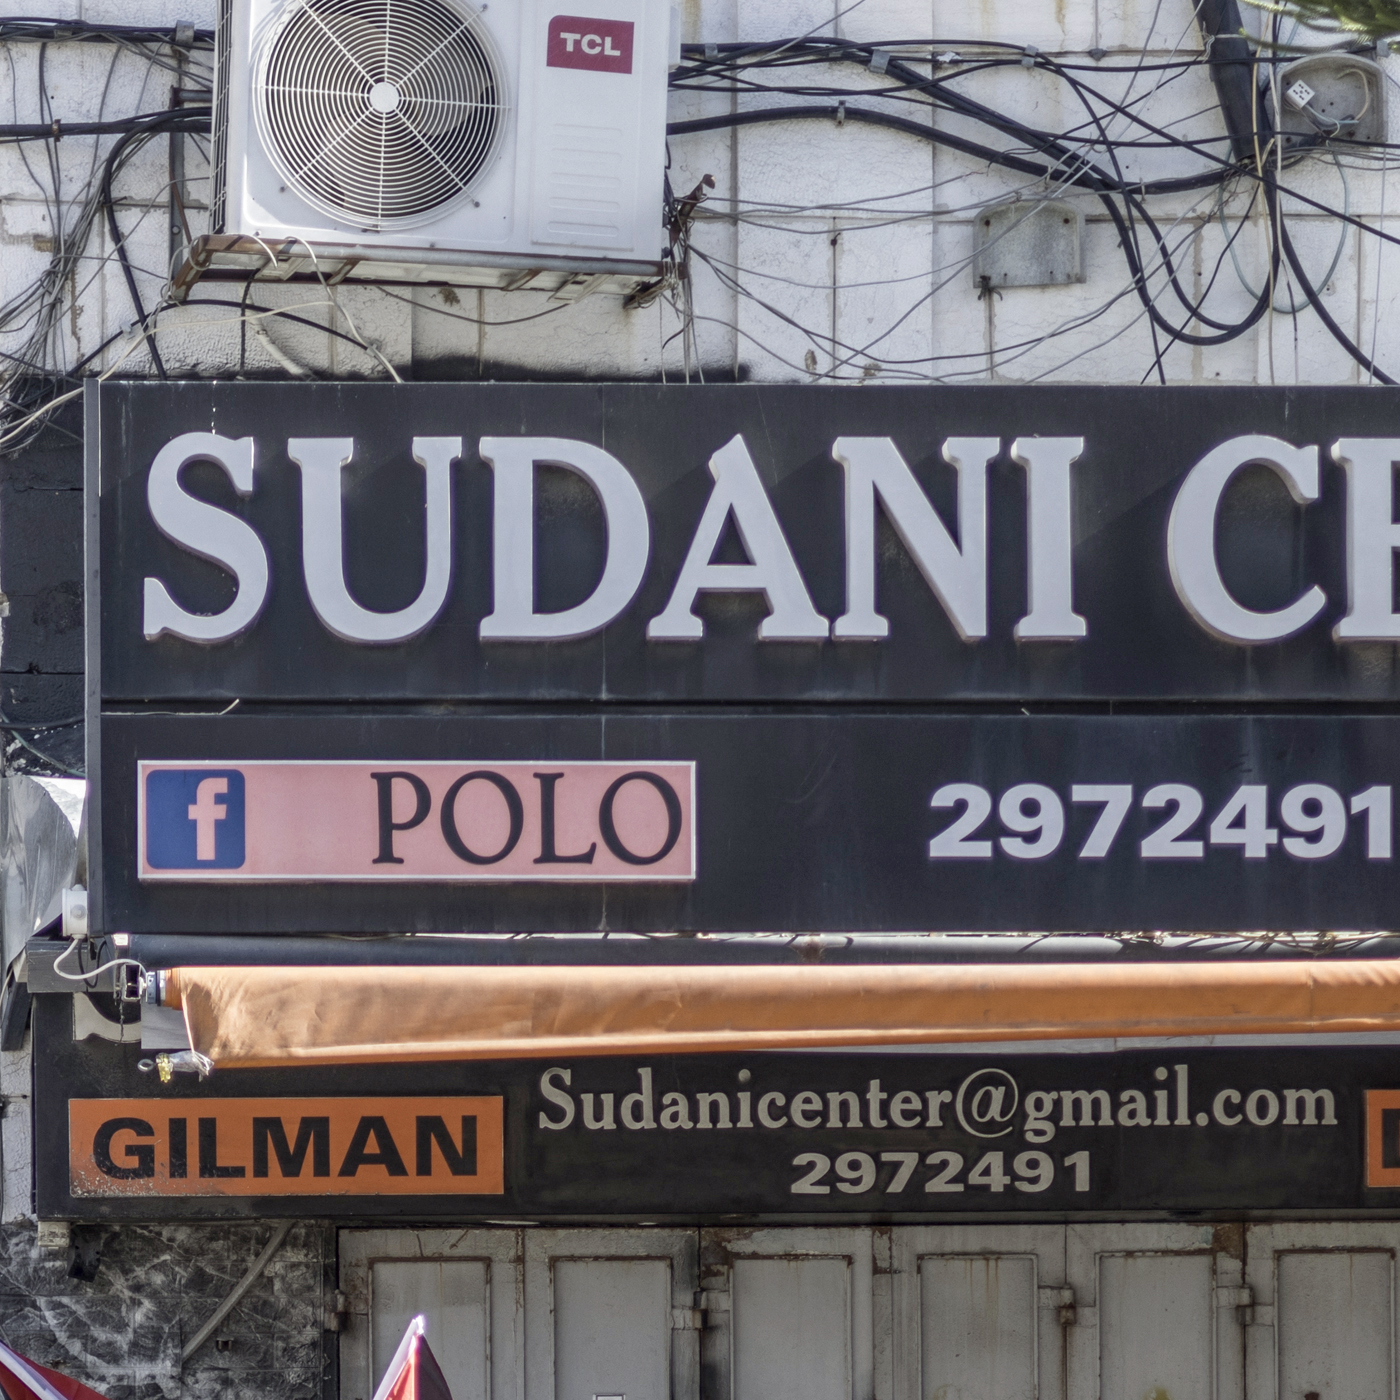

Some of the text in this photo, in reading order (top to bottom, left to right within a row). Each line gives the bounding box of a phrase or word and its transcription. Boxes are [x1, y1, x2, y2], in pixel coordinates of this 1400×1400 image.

[560, 32, 621, 57] TCL
[143, 430, 1088, 646] SUDANI
[371, 769, 682, 865] POLO
[928, 783, 1392, 859] 2972491
[538, 1064, 1338, 1144] Sudanicenter@gmail.com
[92, 1114, 478, 1180] GILMAN
[791, 1149, 1091, 1195] 2972491
